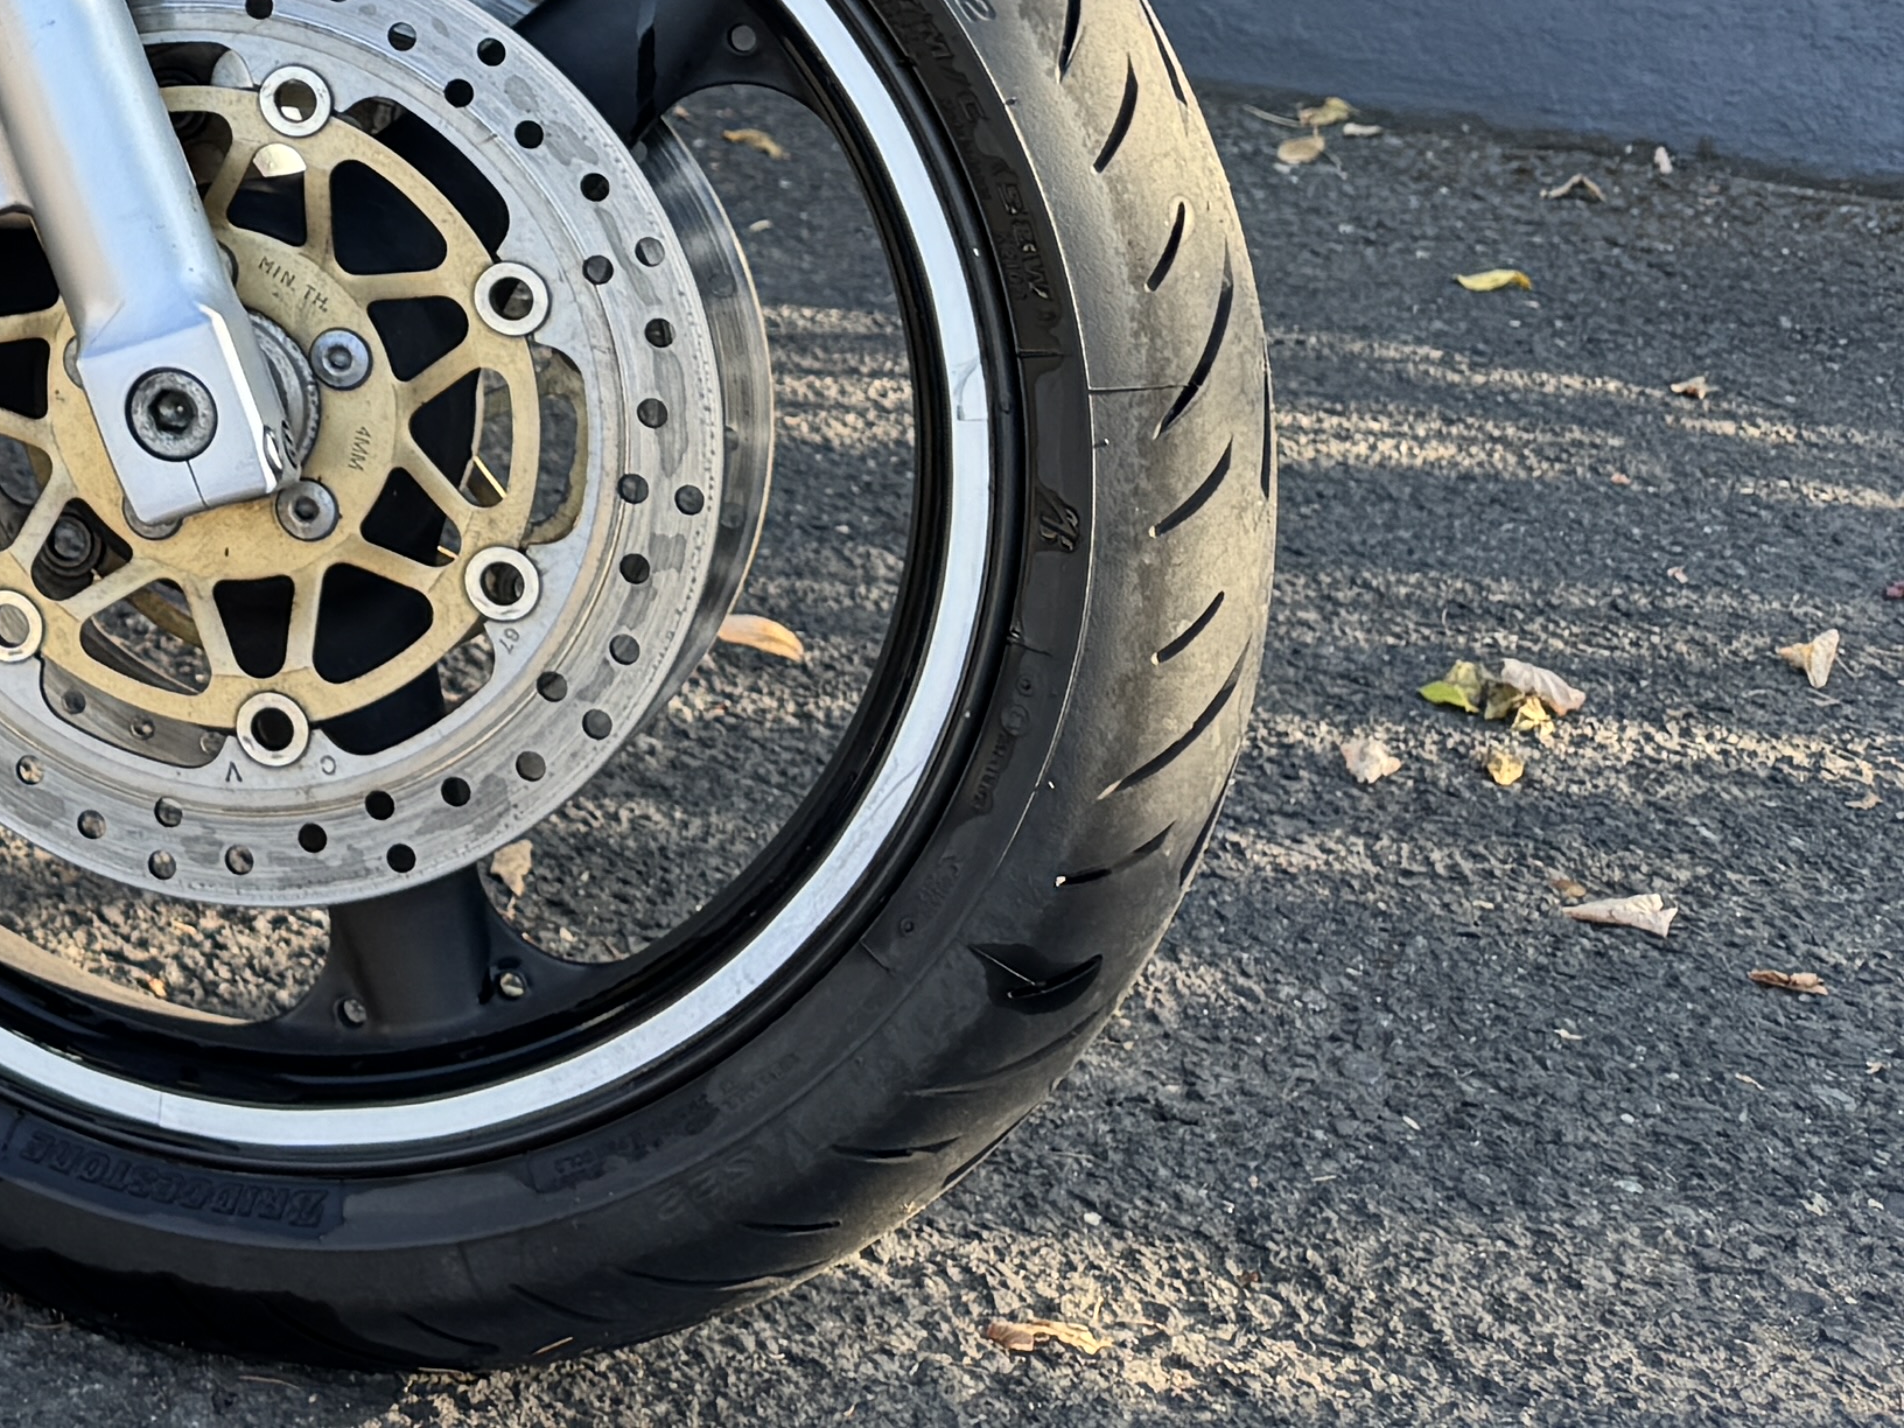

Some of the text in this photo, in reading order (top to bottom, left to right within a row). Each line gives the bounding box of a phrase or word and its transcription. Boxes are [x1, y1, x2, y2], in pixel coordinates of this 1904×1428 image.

[257, 255, 297, 292] MIN.
[348, 425, 373, 472] 4MM
[19, 1129, 331, 1229] BRIDGESTONE
